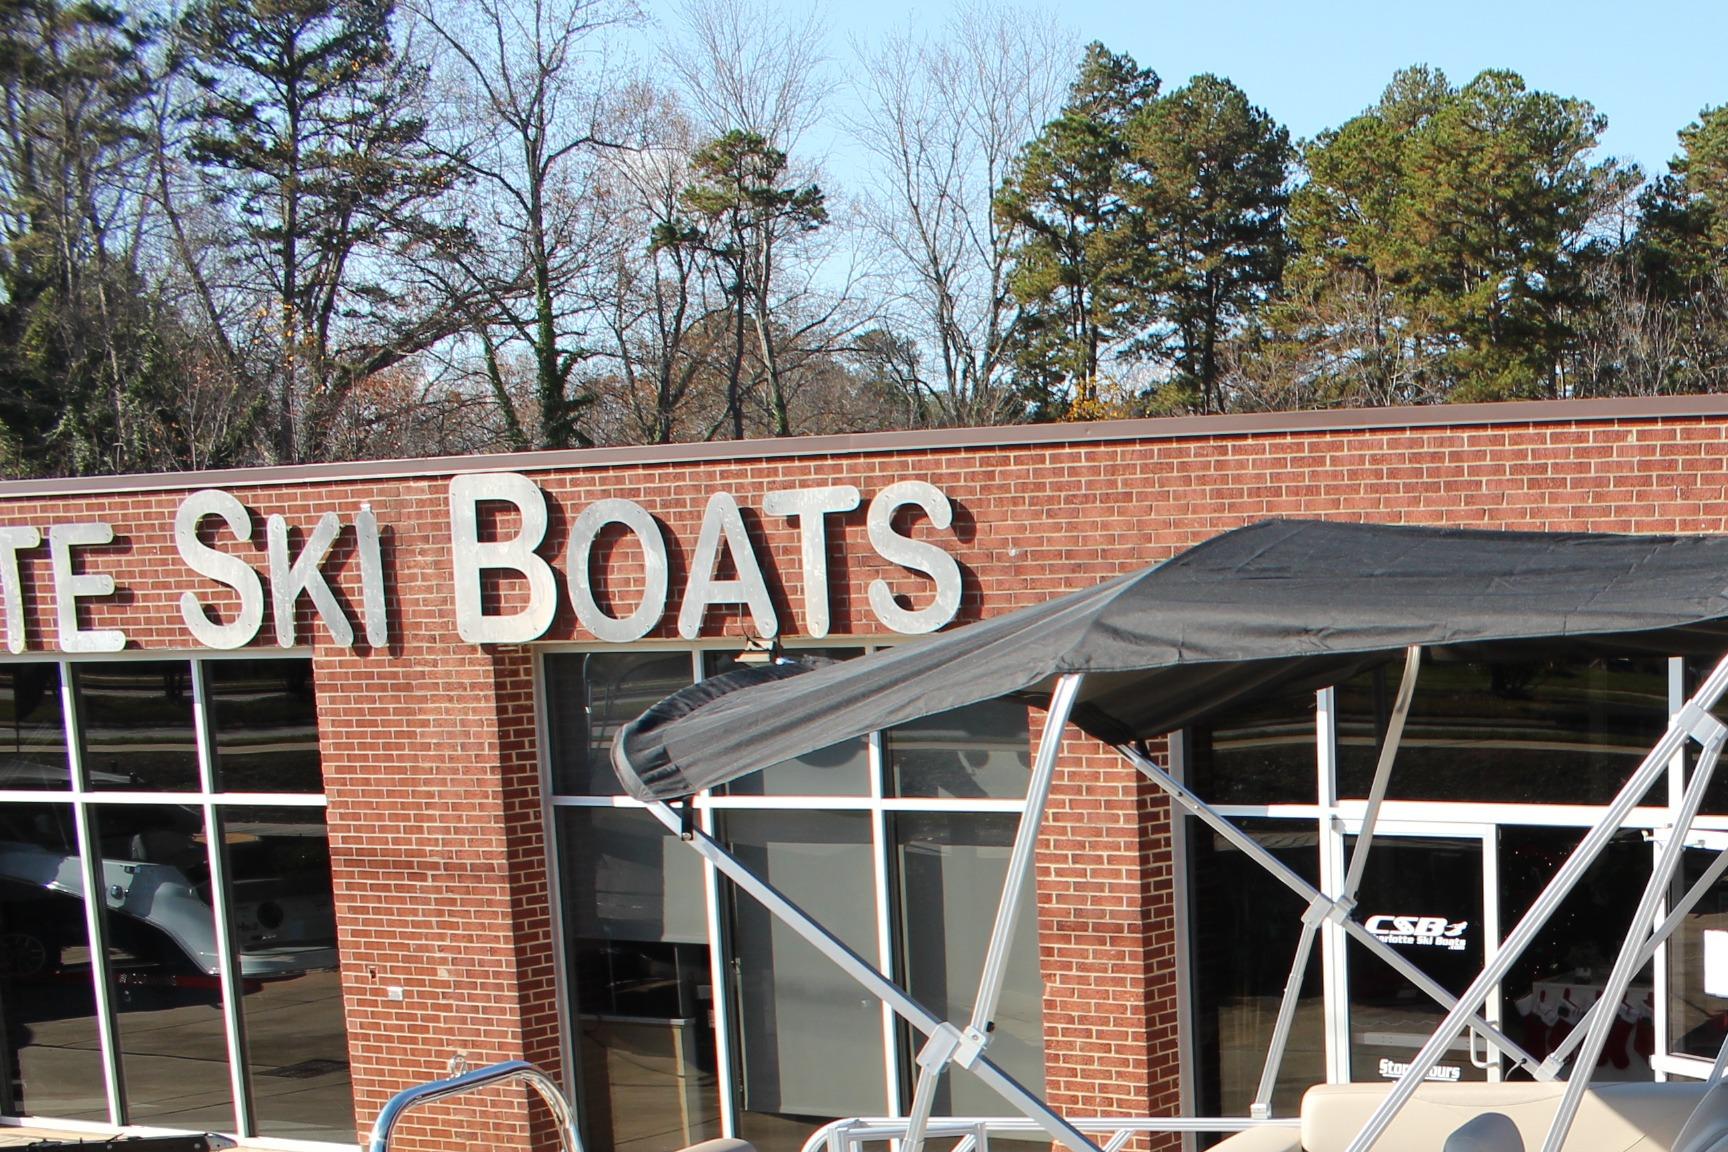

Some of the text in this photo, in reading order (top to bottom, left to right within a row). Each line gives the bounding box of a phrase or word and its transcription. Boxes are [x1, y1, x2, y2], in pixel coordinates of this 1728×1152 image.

[175, 489, 388, 650] SKI
[448, 473, 962, 645] BOATS
[1364, 915, 1448, 936] CSB
[1379, 1058, 1461, 1079] Stor ours
